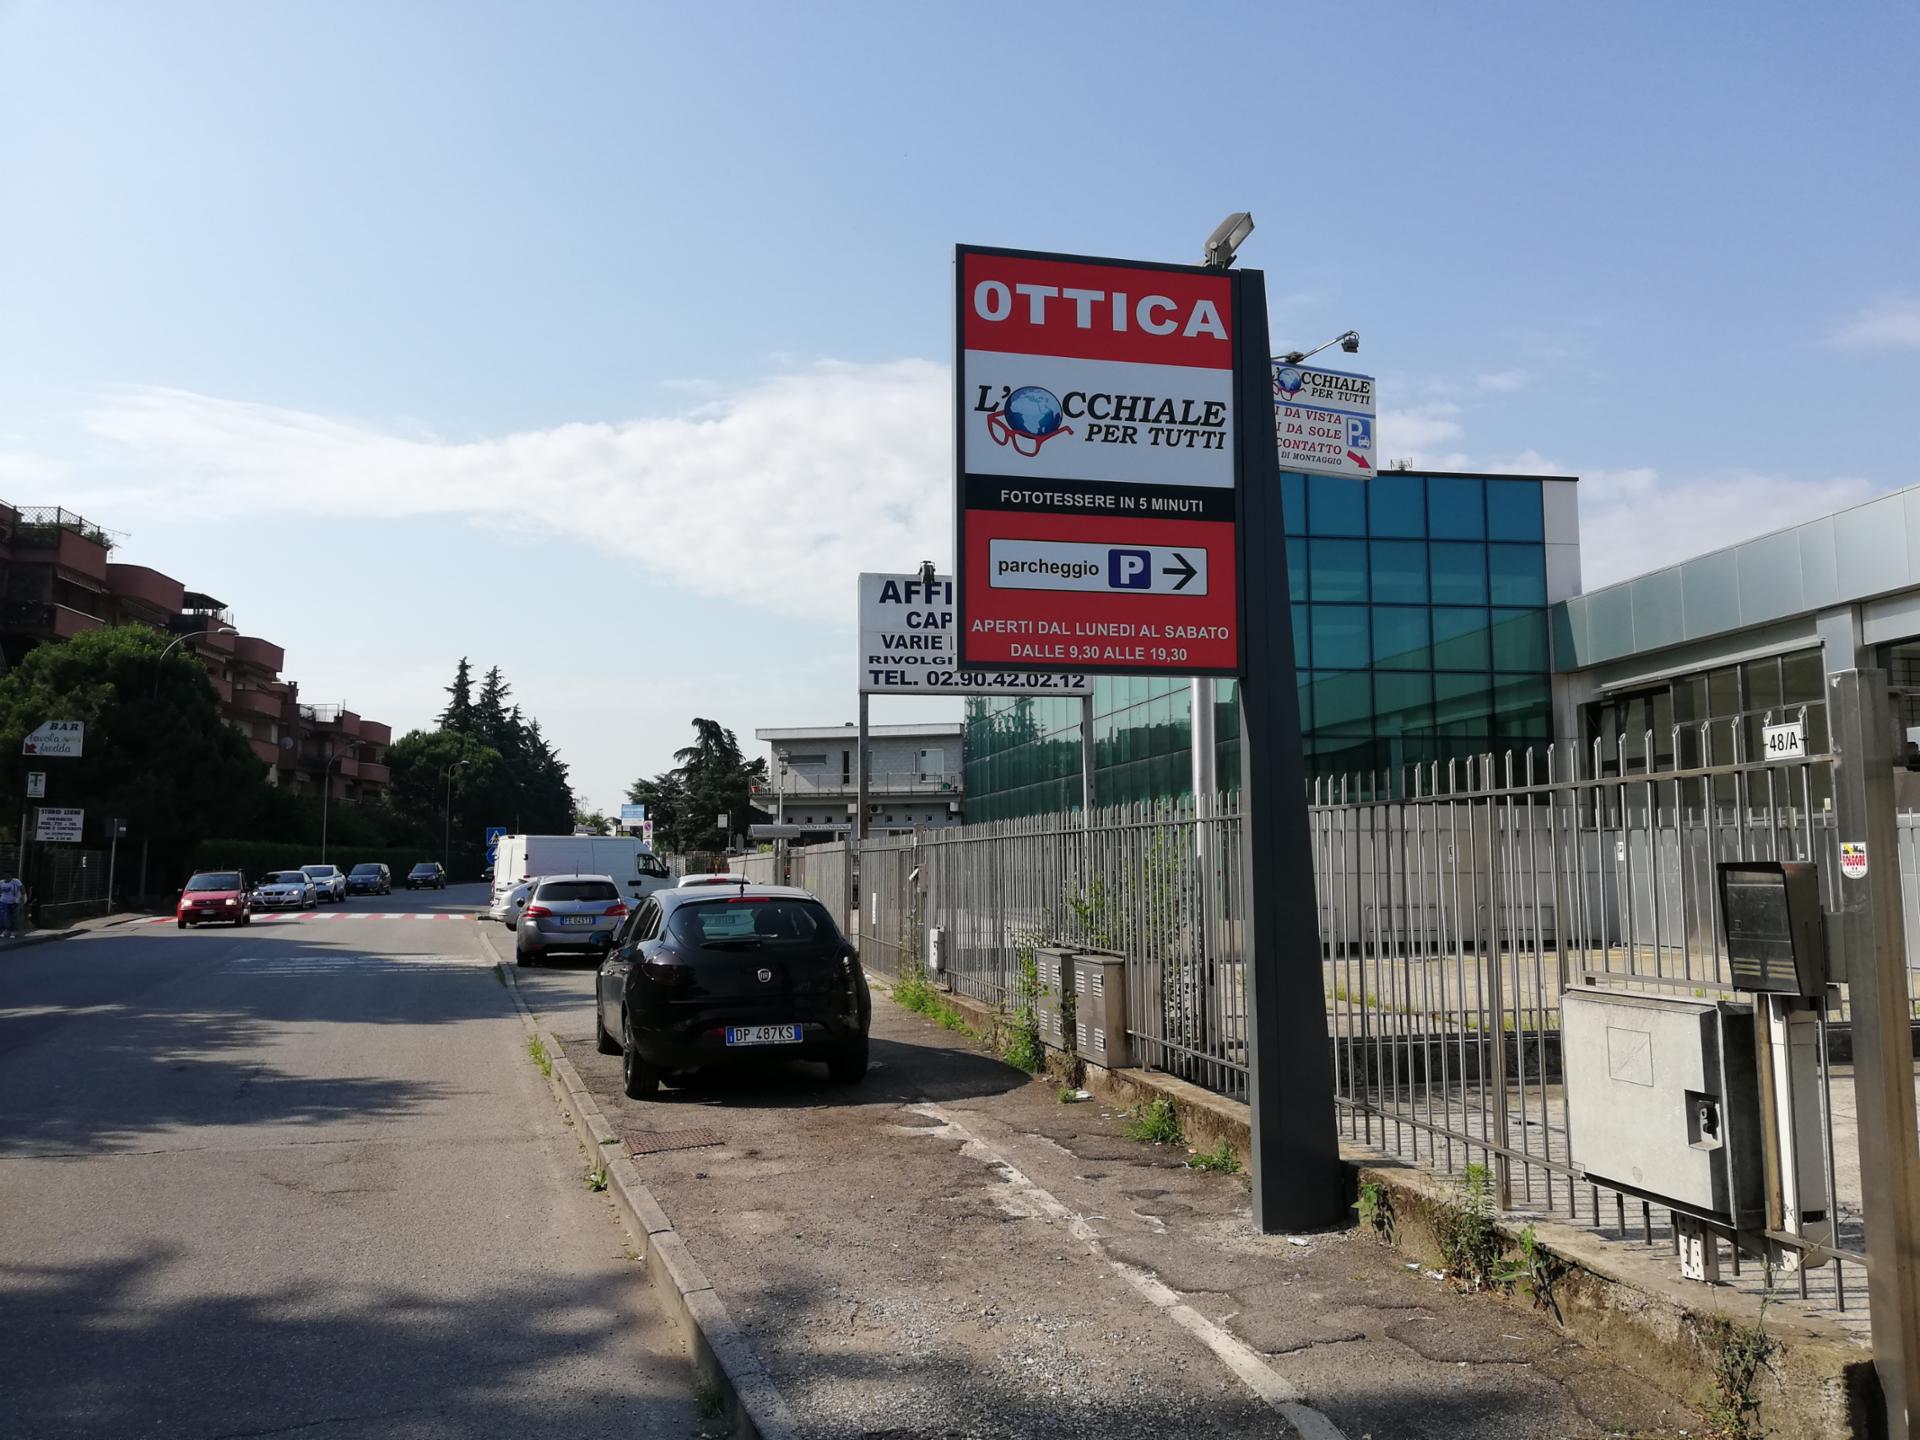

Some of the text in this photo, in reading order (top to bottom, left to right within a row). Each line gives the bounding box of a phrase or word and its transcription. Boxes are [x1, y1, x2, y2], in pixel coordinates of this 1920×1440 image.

[974, 280, 1229, 340] OTTICA
[1311, 387, 1370, 405] PER TUTTI
[1285, 407, 1301, 419] DA
[1306, 410, 1342, 424] VISTA
[1085, 423, 1226, 449] PER TUTTI
[1287, 423, 1303, 435] DA
[1308, 426, 1342, 440] SOLE
[1281, 450, 1342, 465] DI MONTAGGIO
[1000, 490, 1203, 512] FOTOTESSERE IN 5 MINUTI
[998, 558, 1099, 579] parcheggio
[906, 611, 952, 629] CAP
[972, 620, 1229, 640] APERTI DAL LUNEDI AL SABATO
[881, 634, 943, 650] VARIE
[1010, 643, 1187, 662] DALLE 9,30 ALLE 19,30
[869, 669, 1085, 688] TEL. 02.90.42.02.12
[49, 722, 79, 731] BAR
[1769, 731, 1798, 752] 48/A
